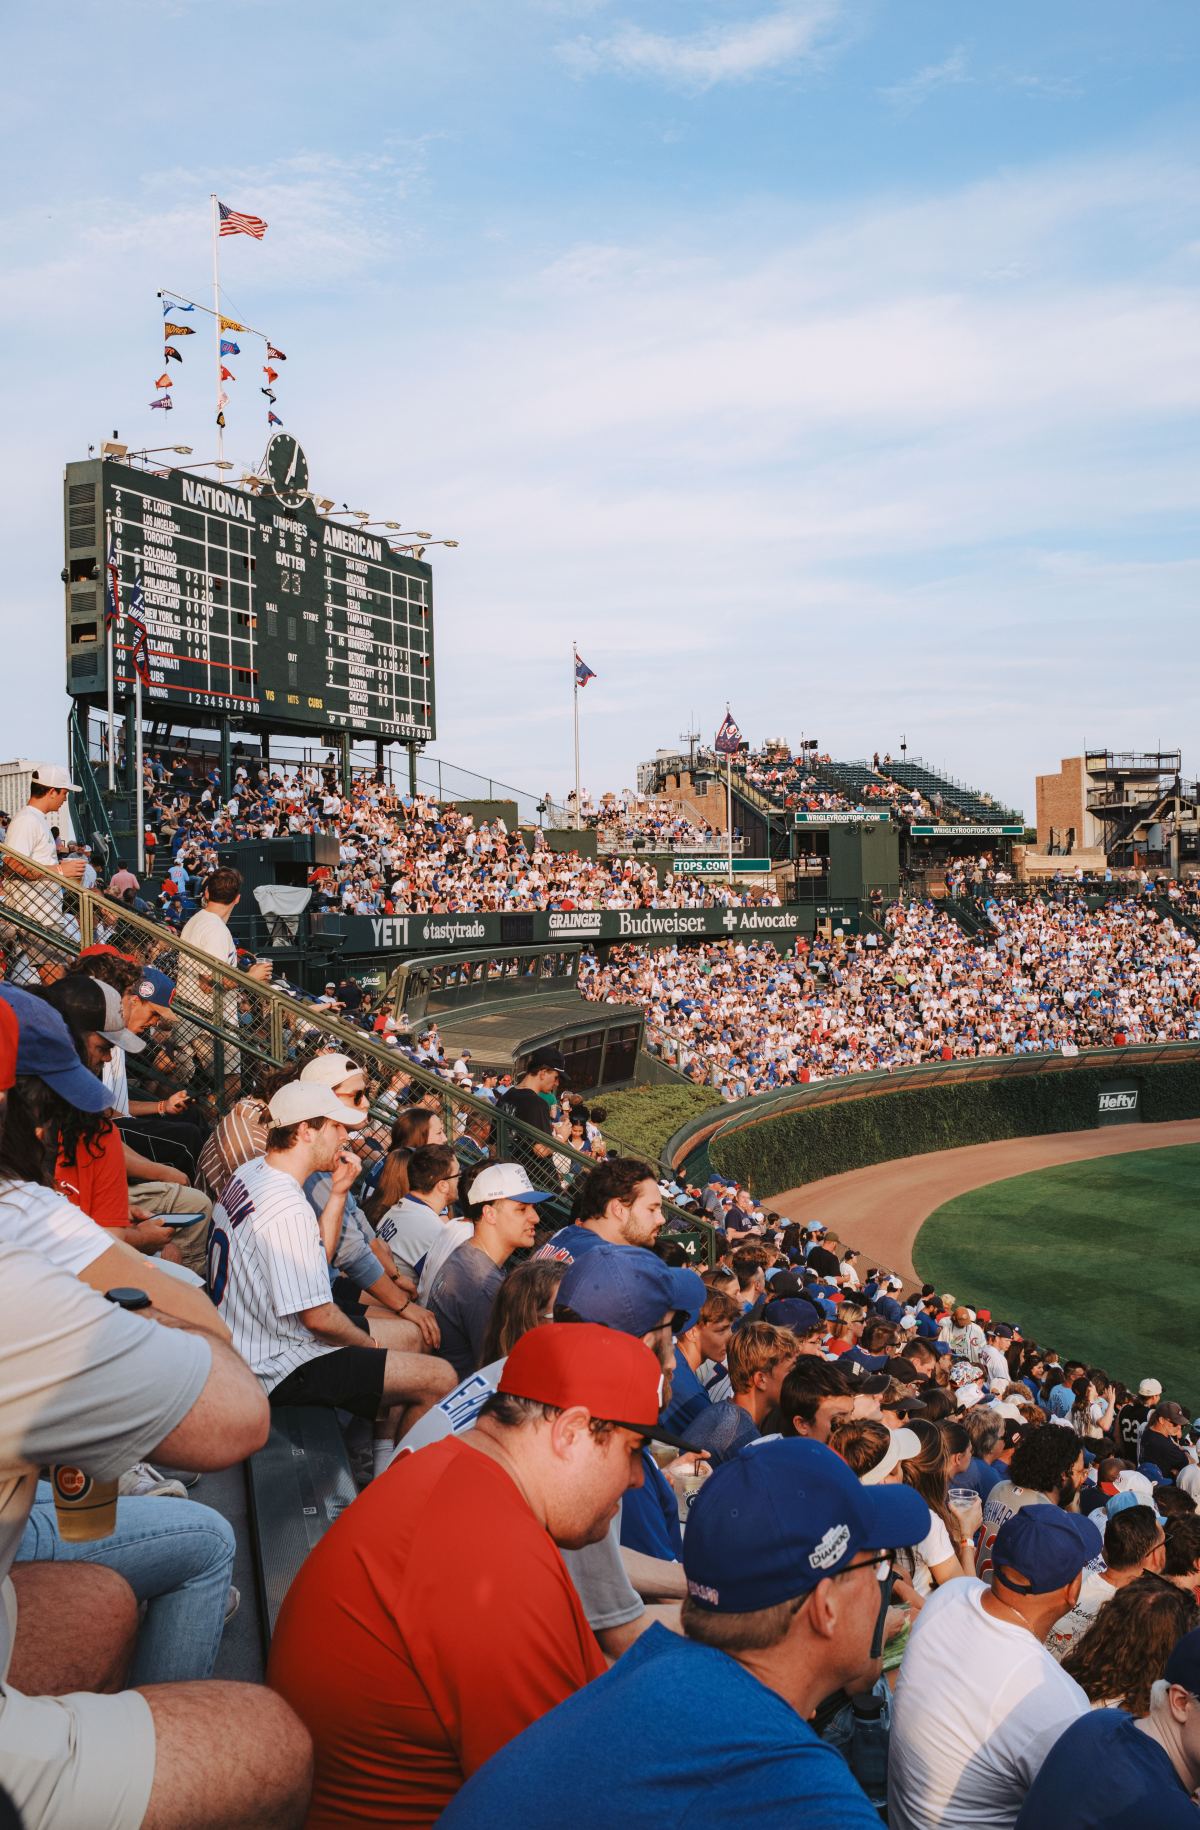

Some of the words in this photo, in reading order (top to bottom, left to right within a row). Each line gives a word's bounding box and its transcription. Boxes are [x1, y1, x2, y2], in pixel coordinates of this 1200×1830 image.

[115, 490, 121, 501] 2
[143, 498, 152, 512] ST.
[153, 501, 172, 517] LOUIS
[182, 478, 256, 523] NATIONAL
[115, 506, 121, 518] 6
[143, 514, 153, 526] LOS
[114, 522, 122, 533] 10
[143, 529, 173, 547] TORONTO
[260, 523, 273, 534] PLATE
[272, 514, 308, 538] UMPIRES
[115, 538, 122, 549] 6
[143, 545, 177, 564] COLORADO
[323, 525, 382, 562] AMERICAN
[143, 560, 178, 579] BALTIMORE
[275, 551, 306, 572] BATTER
[143, 575, 181, 595] PHILADELPHIA
[281, 570, 301, 595] 23
[144, 591, 180, 610] CLEVELAND
[266, 602, 279, 613] BALL
[346, 598, 361, 611] TEXAS
[144, 607, 158, 621] NEW
[158, 608, 174, 623] YORK
[302, 611, 319, 623] STRIKE
[326, 606, 333, 617] 15
[346, 611, 362, 625] TAMPA
[116, 633, 125, 644] 14
[338, 636, 344, 647] 16
[347, 638, 374, 654] MINNESOTA
[116, 650, 126, 661] 40
[287, 652, 298, 662] OUT
[117, 666, 126, 677] 41
[348, 664, 366, 677] KANSAS
[348, 677, 368, 691] BOSTON
[117, 682, 126, 692] SP
[196, 694, 200, 705] 2
[204, 694, 209, 706] 3
[210, 696, 216, 707] 4
[218, 697, 223, 708] 5
[225, 698, 230, 709] 6
[232, 699, 237, 711] 7
[240, 700, 244, 712] 8
[246, 702, 252, 713] 9
[252, 702, 260, 714] 10
[266, 690, 275, 701] VIS
[287, 694, 300, 705] HITS
[308, 696, 323, 709] CUBS
[348, 691, 369, 704] CHICAGO
[348, 703, 369, 717] SEATTLE
[549, 913, 601, 929] GRAINGER
[739, 911, 797, 929] Advocate
[371, 918, 409, 947] YETI
[430, 920, 485, 944] tastytrade
[1099, 1094, 1136, 1109] Hefty
